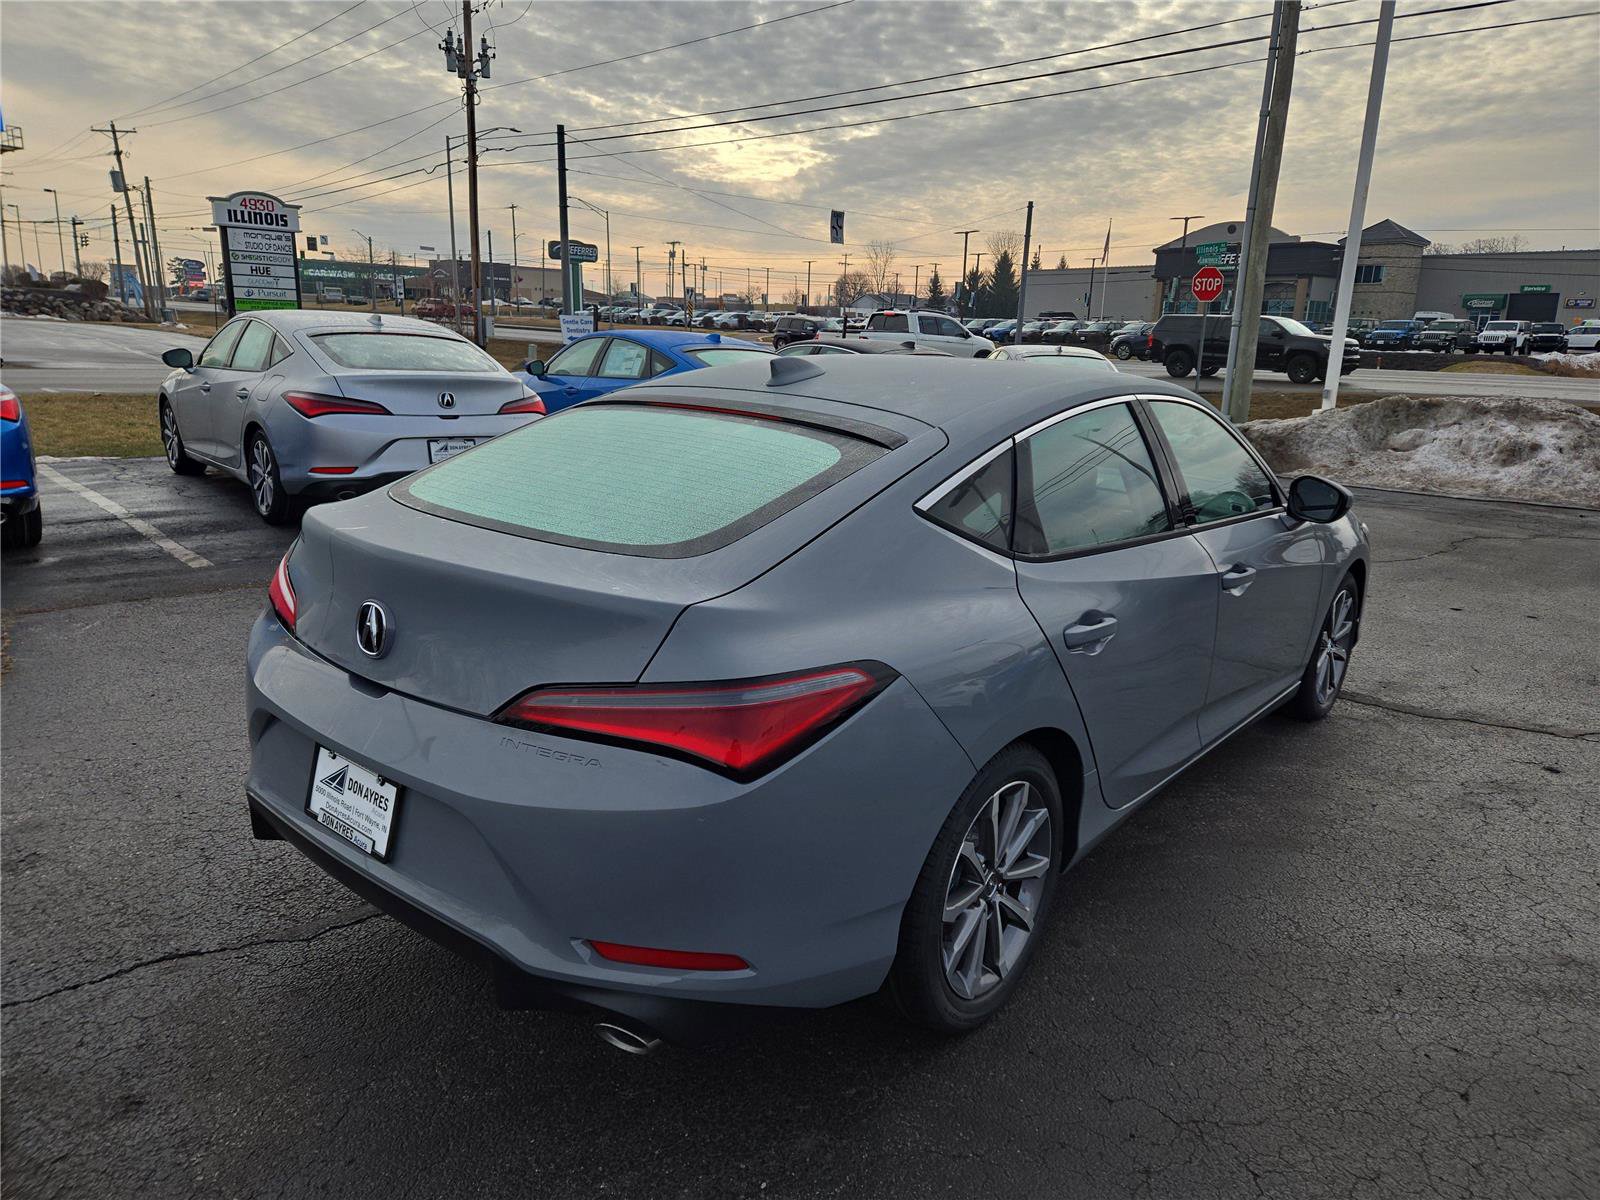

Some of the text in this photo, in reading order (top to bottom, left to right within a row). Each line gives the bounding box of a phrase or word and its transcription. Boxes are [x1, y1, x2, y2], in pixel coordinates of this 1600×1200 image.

[240, 197, 275, 212] 4930
[227, 209, 288, 227] ILLINOIS
[245, 241, 263, 251] STUDIO
[272, 243, 292, 253] DANCE
[250, 266, 271, 275] HUE
[1194, 278, 1222, 291] STOP
[257, 289, 288, 298] Pursuit
[566, 327, 591, 335] Dentistry
[499, 737, 602, 768] INTEGRA
[340, 800, 352, 813] Road
[355, 808, 364, 820] Fort
[381, 825, 388, 834] IN
[353, 835, 368, 850] Acura
